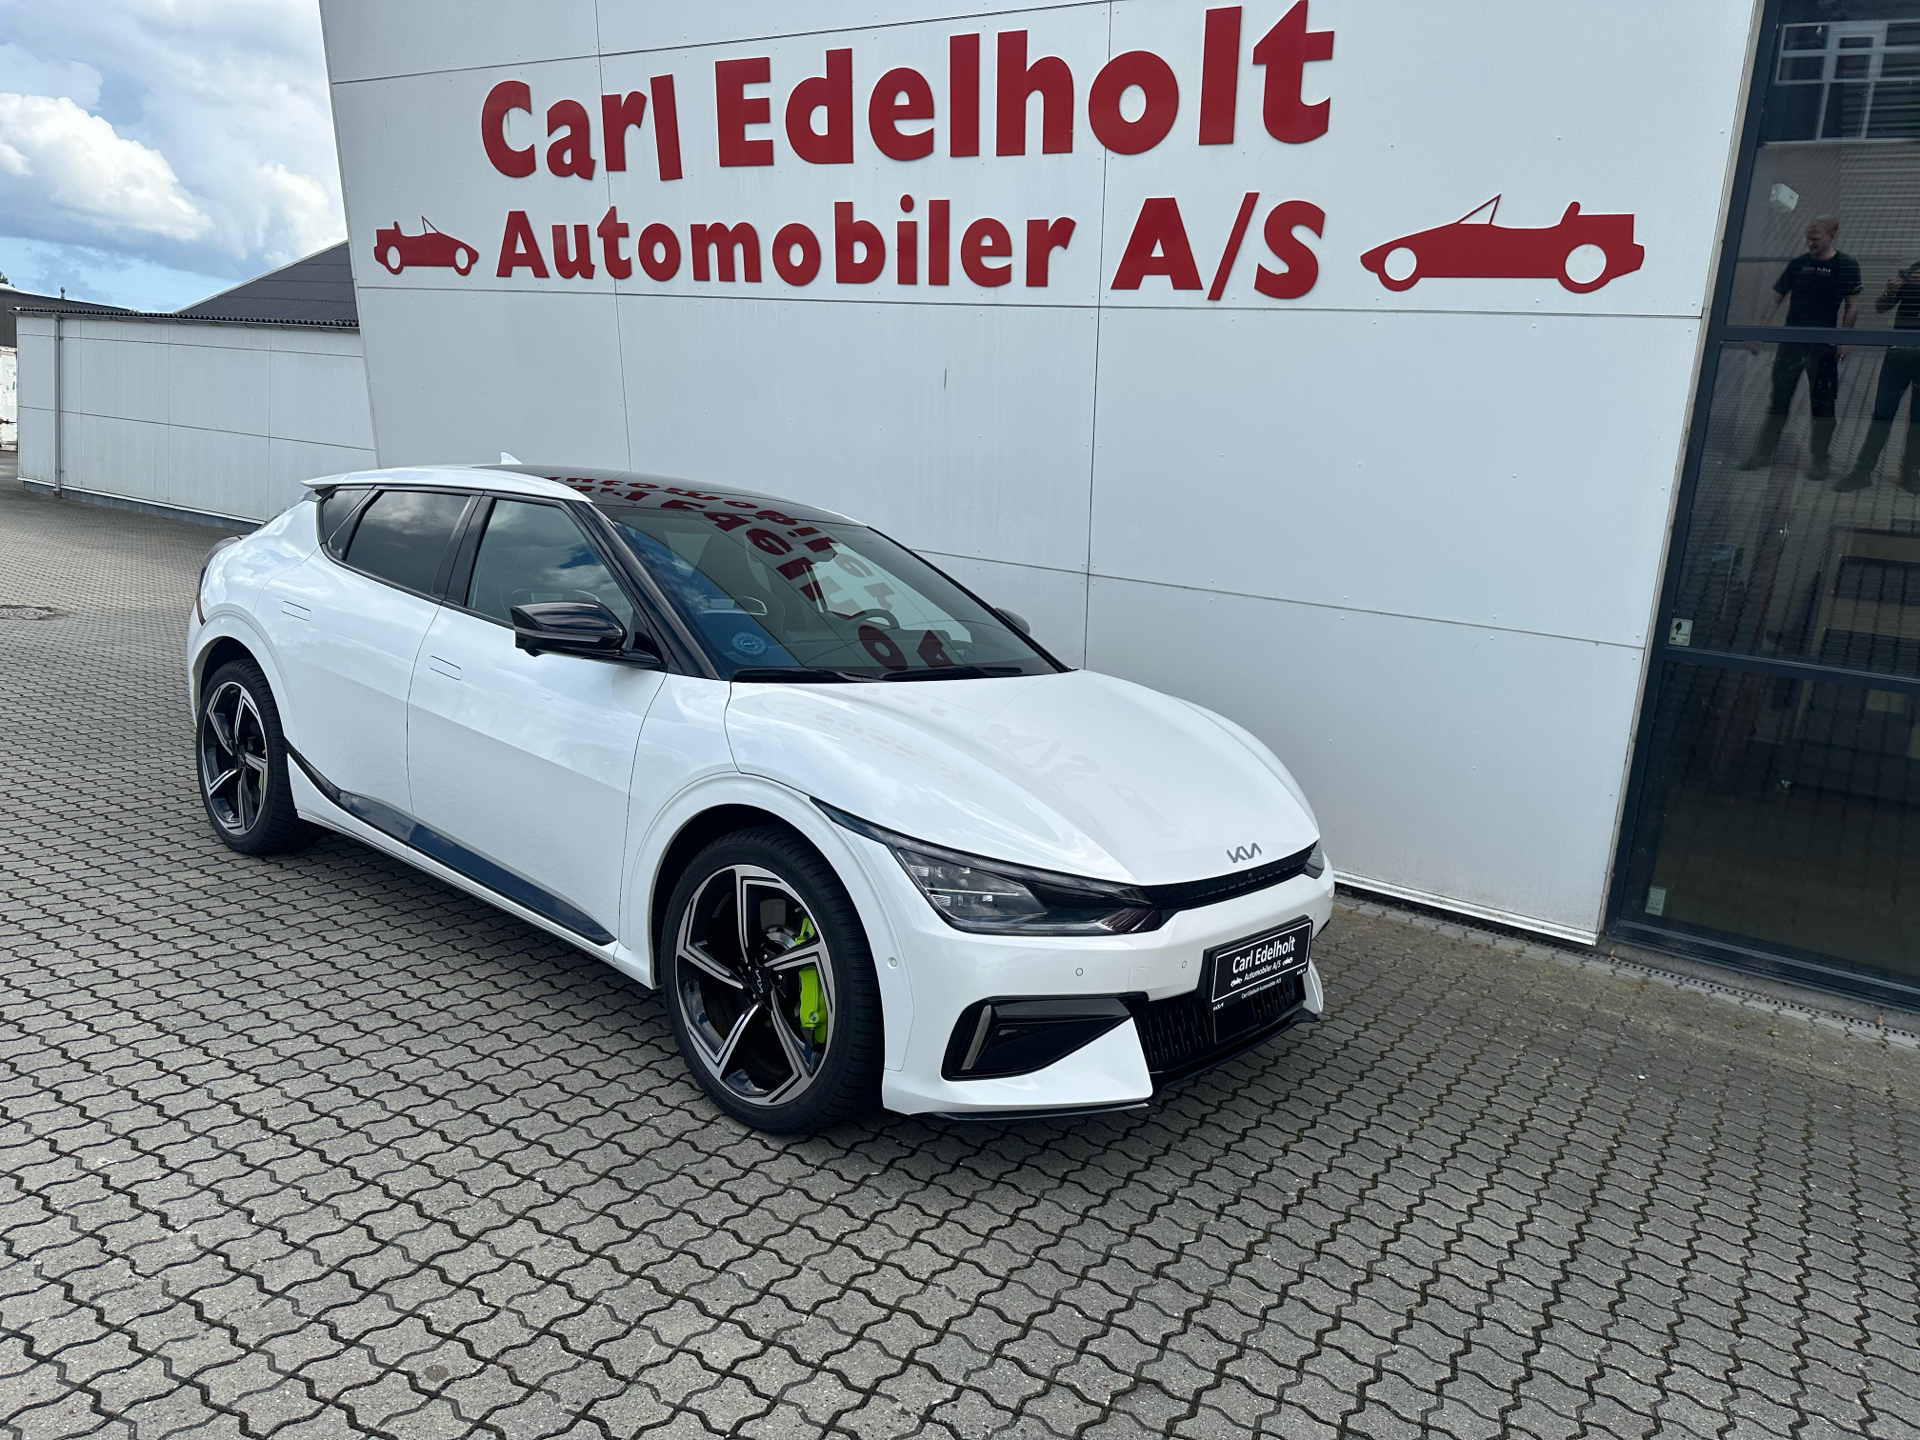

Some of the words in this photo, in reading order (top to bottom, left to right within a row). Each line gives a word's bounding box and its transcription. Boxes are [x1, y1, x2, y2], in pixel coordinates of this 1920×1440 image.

[482, 74, 682, 180] Carl
[715, 0, 1334, 166] Edelholt
[497, 194, 1076, 287] Automobiler
[1111, 192, 1325, 301] A/S
[1232, 949, 1254, 974] Carl
[1255, 935, 1296, 966] Edelholt
